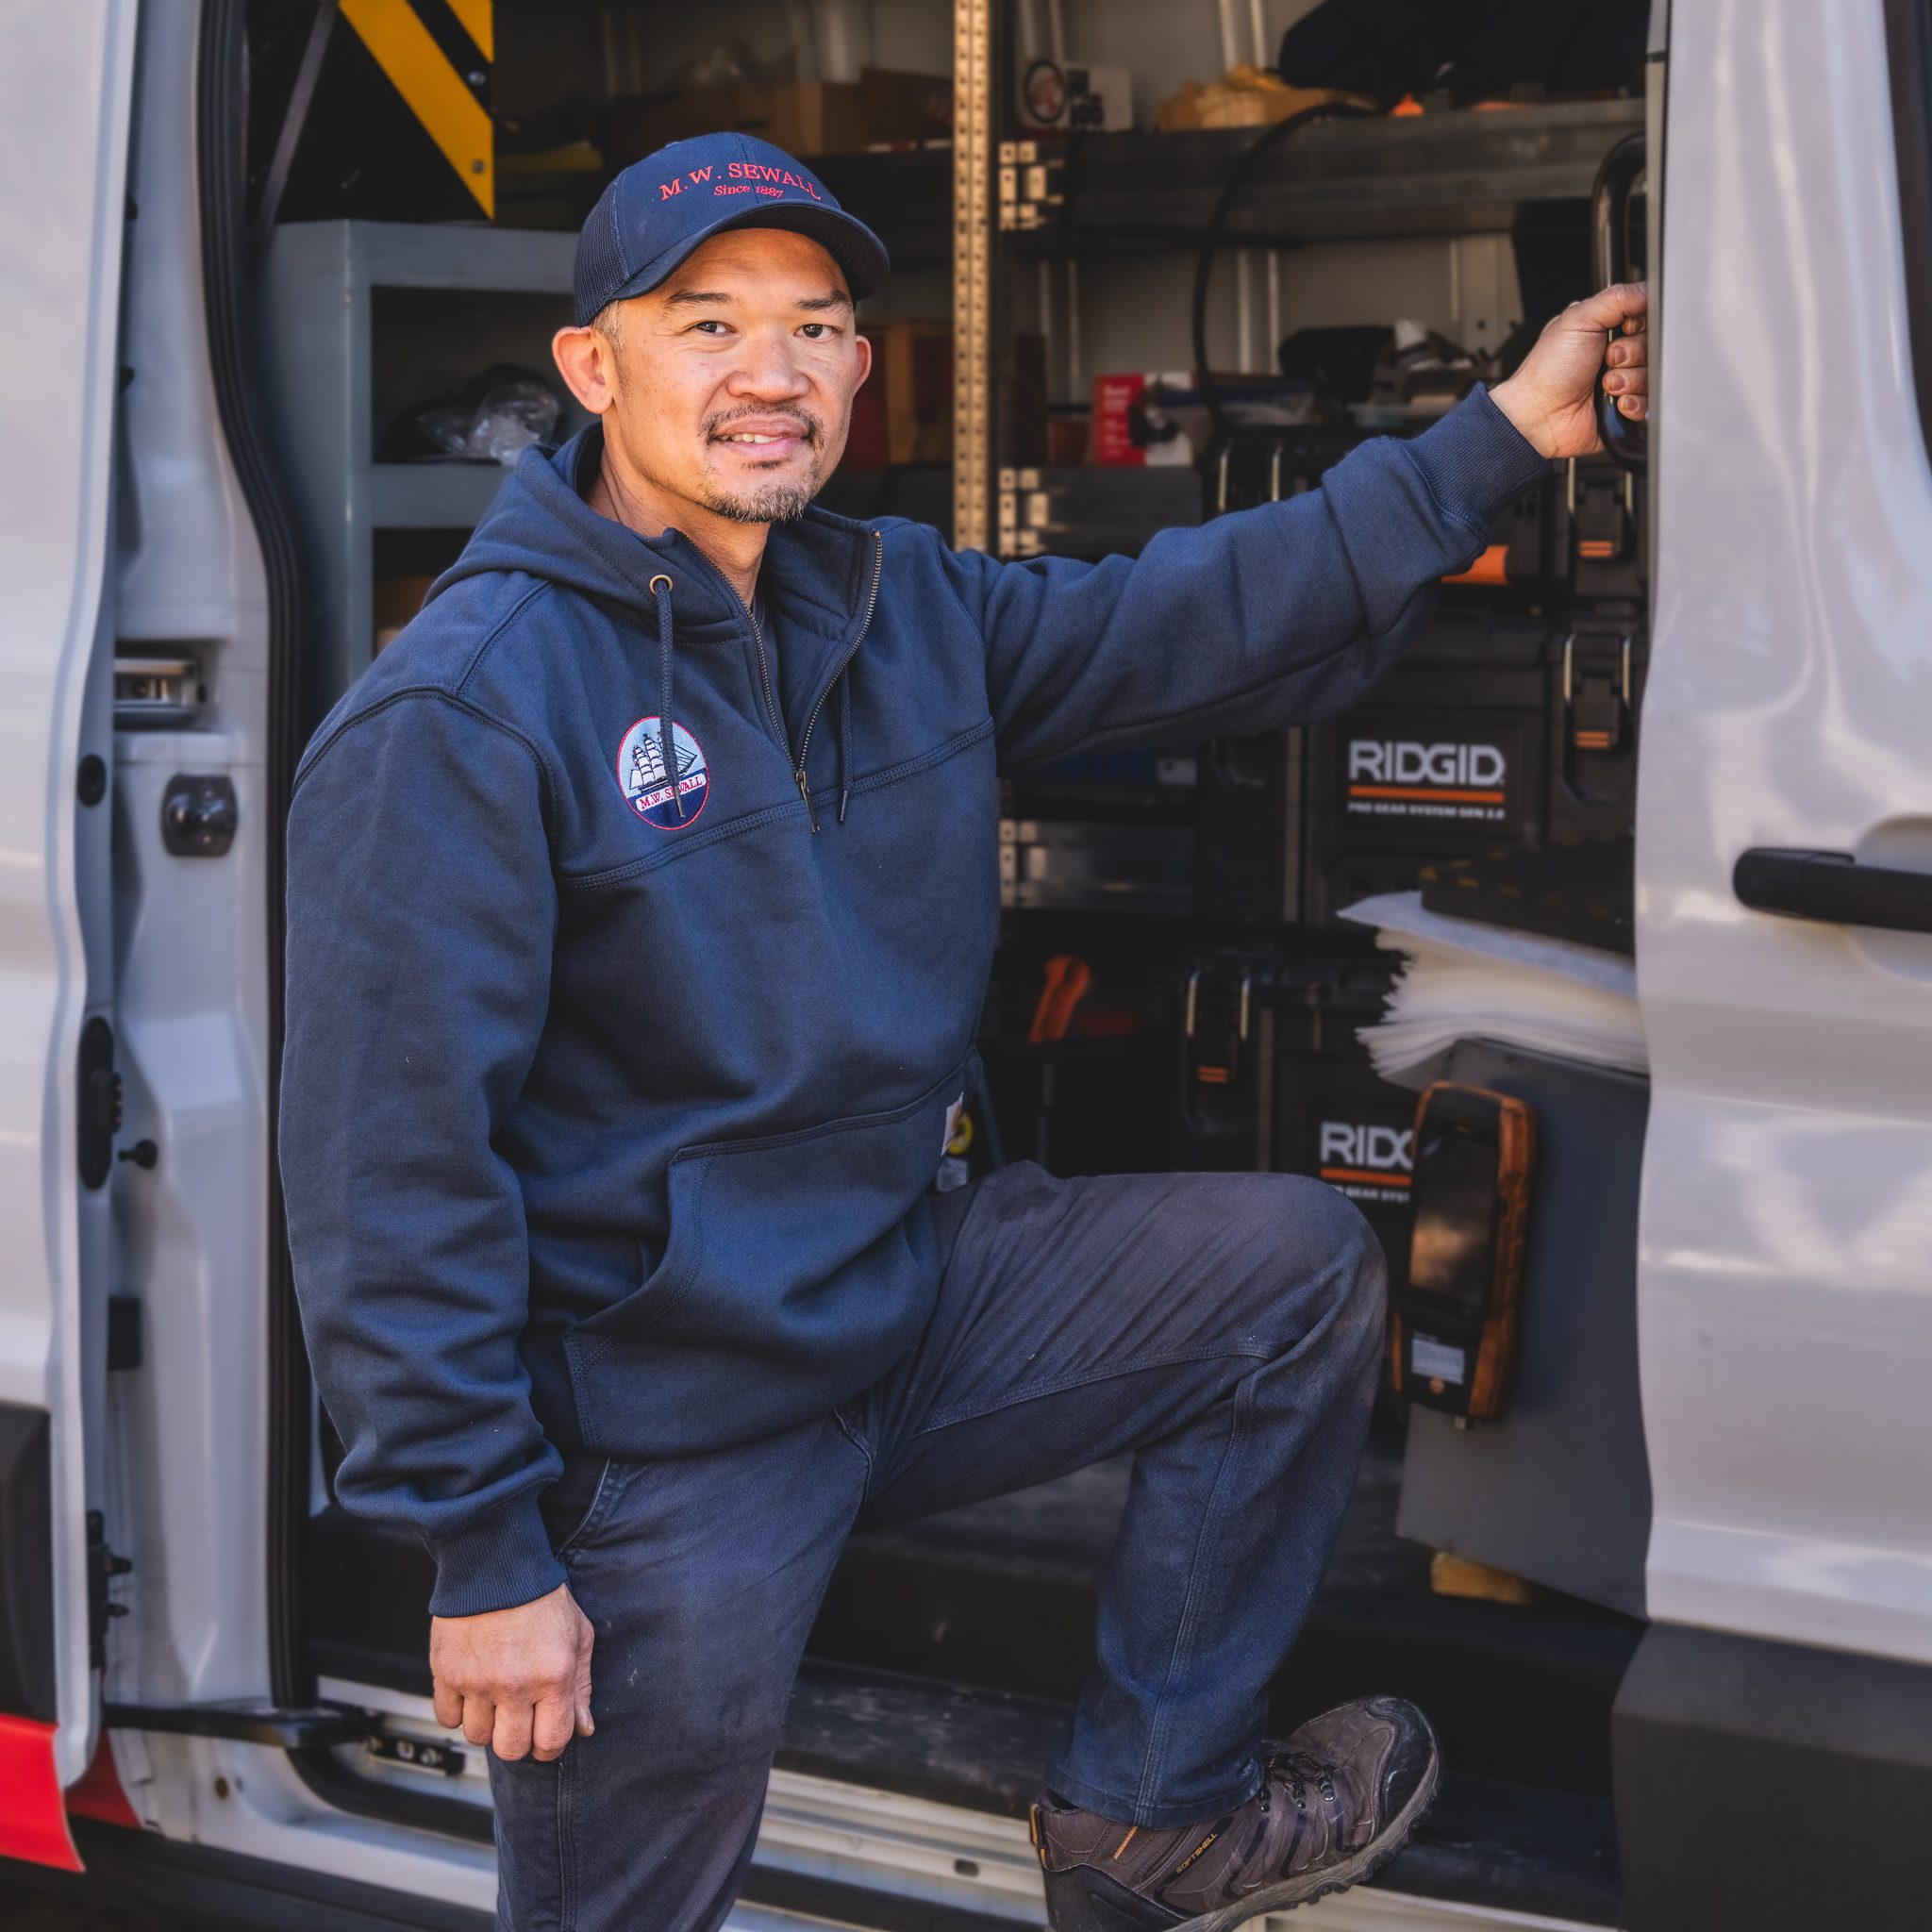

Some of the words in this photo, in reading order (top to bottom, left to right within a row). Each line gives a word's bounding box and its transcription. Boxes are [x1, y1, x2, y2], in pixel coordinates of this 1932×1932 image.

[713, 184, 750, 196] Since
[755, 185, 784, 199] 1887
[727, 162, 822, 201] SEWALL
[1349, 740, 1506, 786] RIDGID
[1408, 805, 1457, 818] SYSTEM
[1458, 807, 1484, 819] GEN
